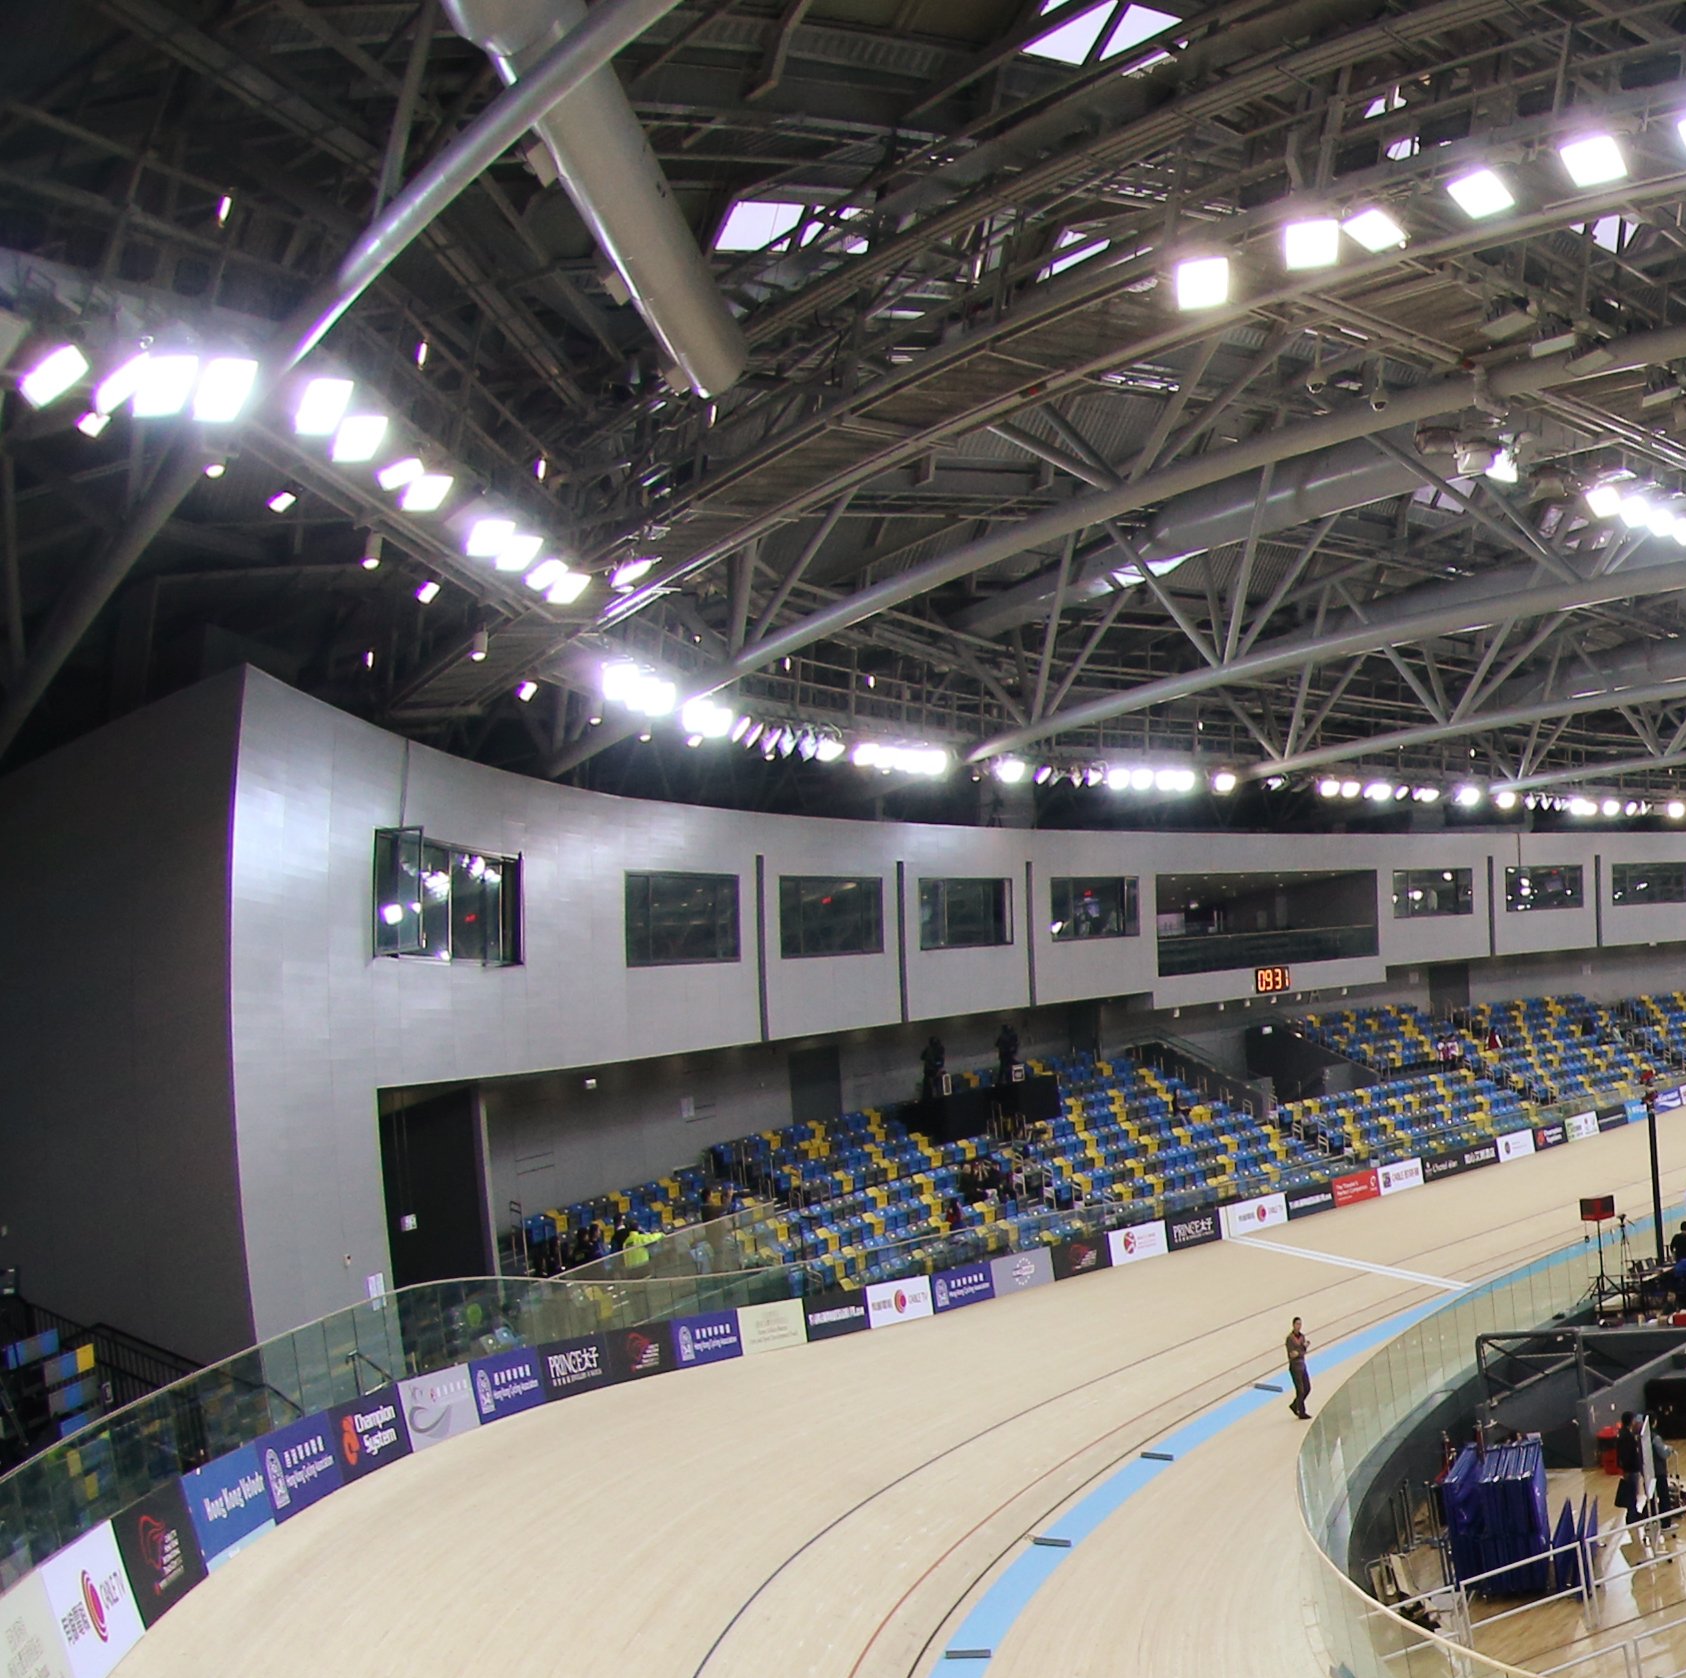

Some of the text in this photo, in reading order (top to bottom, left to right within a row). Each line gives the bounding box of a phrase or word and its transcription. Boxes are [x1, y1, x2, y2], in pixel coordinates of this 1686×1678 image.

[548, 1349, 583, 1378] PRINCE
[354, 1405, 396, 1433] Champion
[363, 1428, 398, 1456] System
